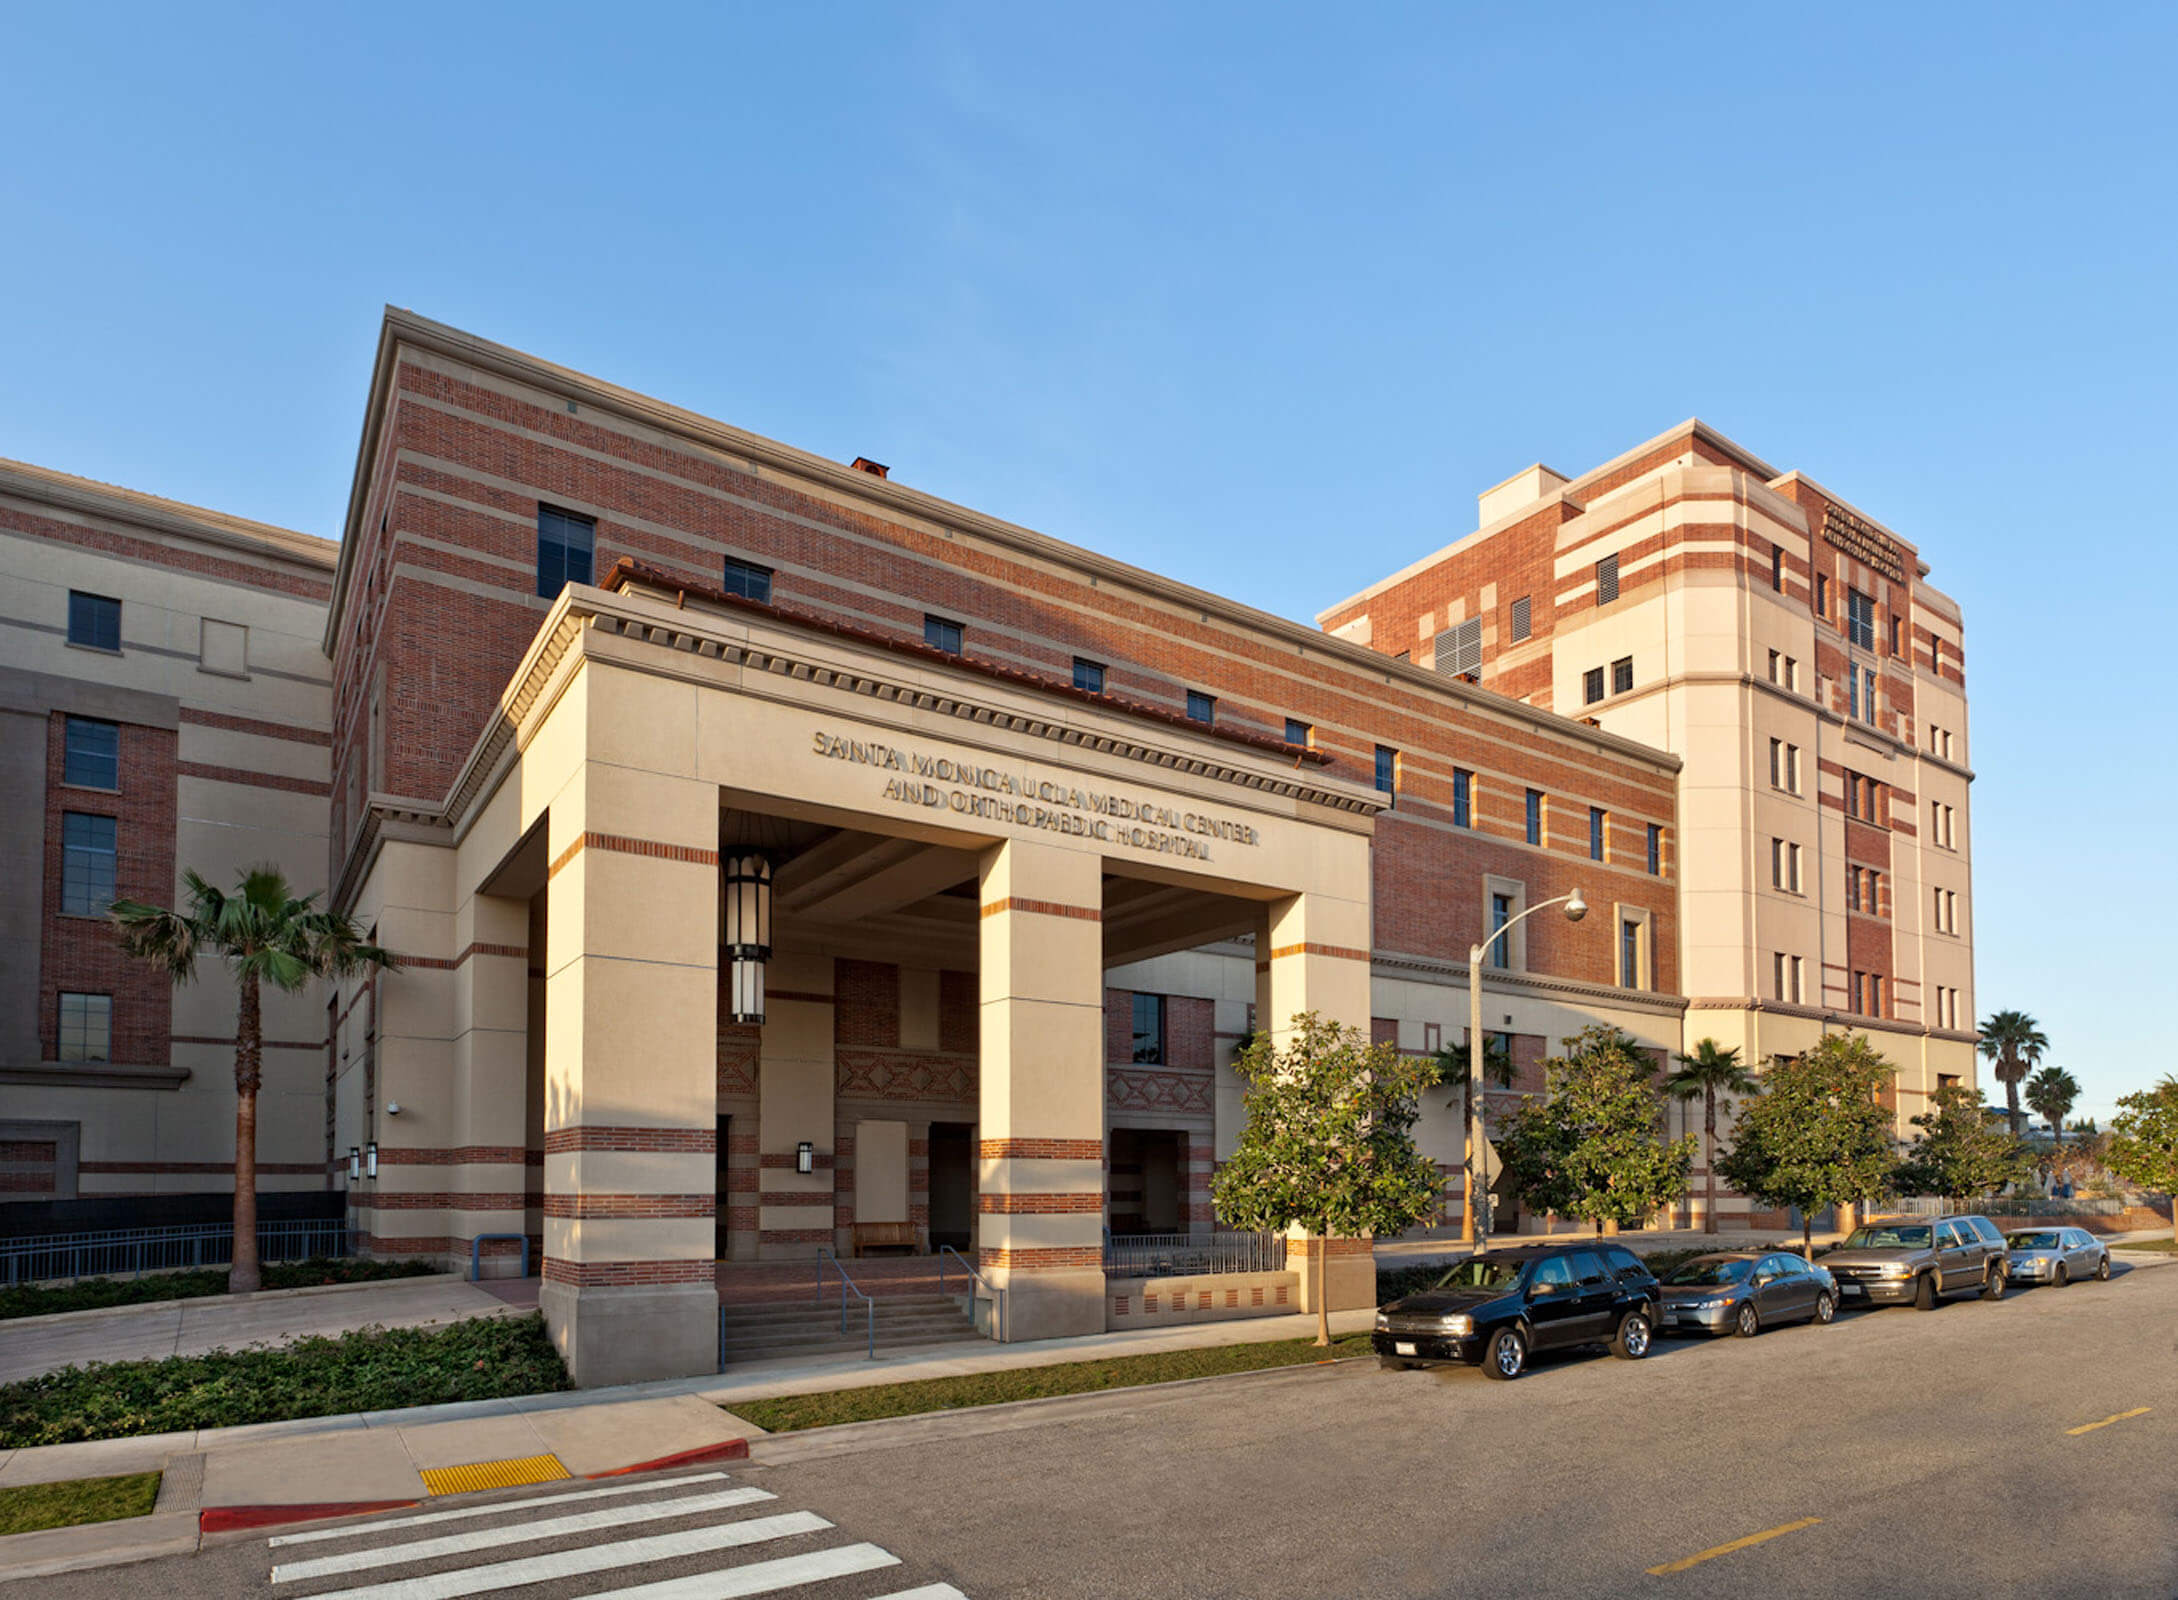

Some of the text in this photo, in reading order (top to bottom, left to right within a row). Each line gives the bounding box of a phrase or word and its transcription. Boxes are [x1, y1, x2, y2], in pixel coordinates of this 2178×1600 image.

[812, 731, 1254, 846] SANTA MONICA UCLA MEDICAL CENTER
[881, 777, 1209, 860] AND ORTHOPAEDIC HOSPITAL
